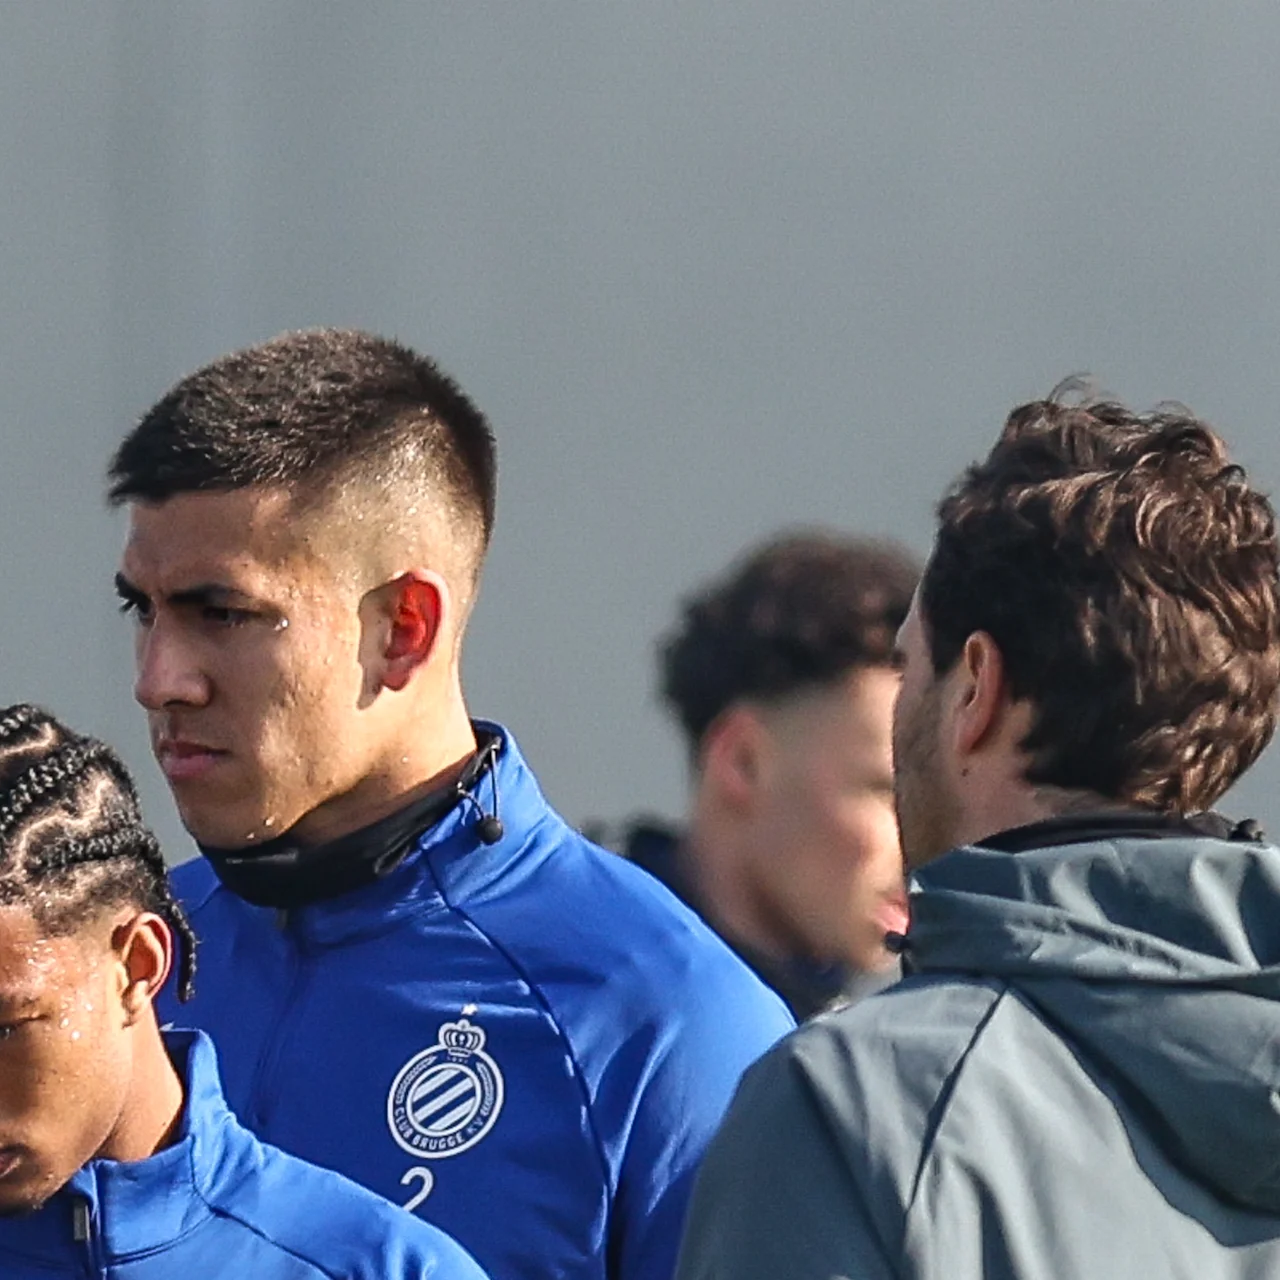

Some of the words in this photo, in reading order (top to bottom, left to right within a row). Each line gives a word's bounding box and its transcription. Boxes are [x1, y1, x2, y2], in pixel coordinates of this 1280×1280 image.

[394, 1106, 414, 1139] CLUB
[411, 1131, 465, 1151] BRUGGE
[400, 1166, 434, 1212] 2
